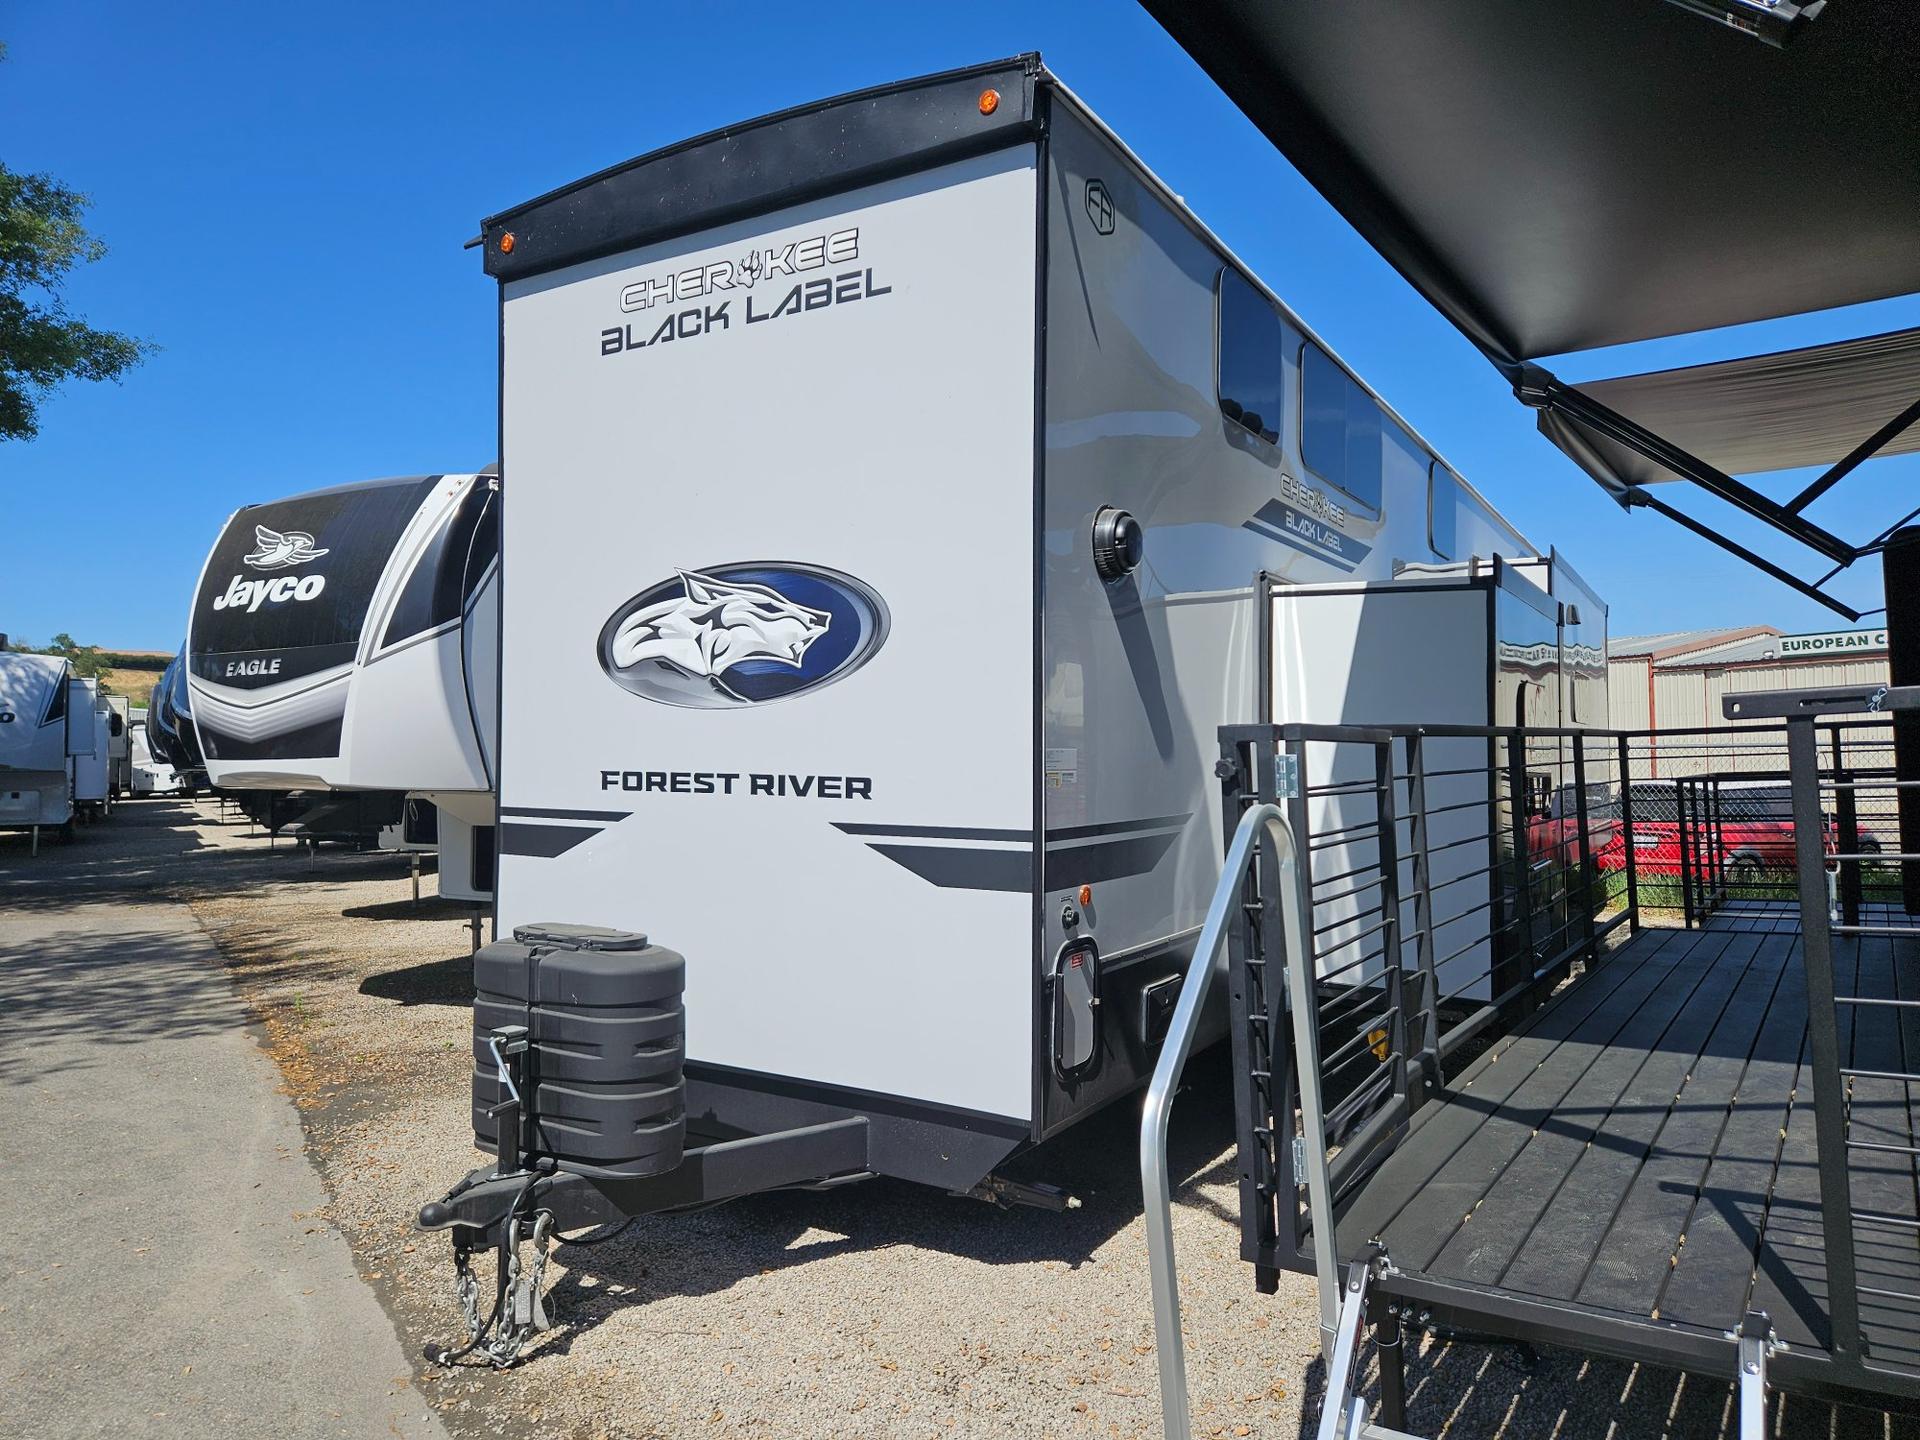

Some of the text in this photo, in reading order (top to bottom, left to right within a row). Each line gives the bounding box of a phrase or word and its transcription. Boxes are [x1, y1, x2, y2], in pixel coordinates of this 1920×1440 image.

[601, 267, 892, 356] BLACK LABEL
[1285, 510, 1343, 553] BLACK LABEL
[213, 574, 326, 613] Jayco
[1781, 634, 1889, 652] EUROPEAN C
[225, 658, 282, 677] EAGLE
[600, 770, 873, 801] FOREST RIVER
